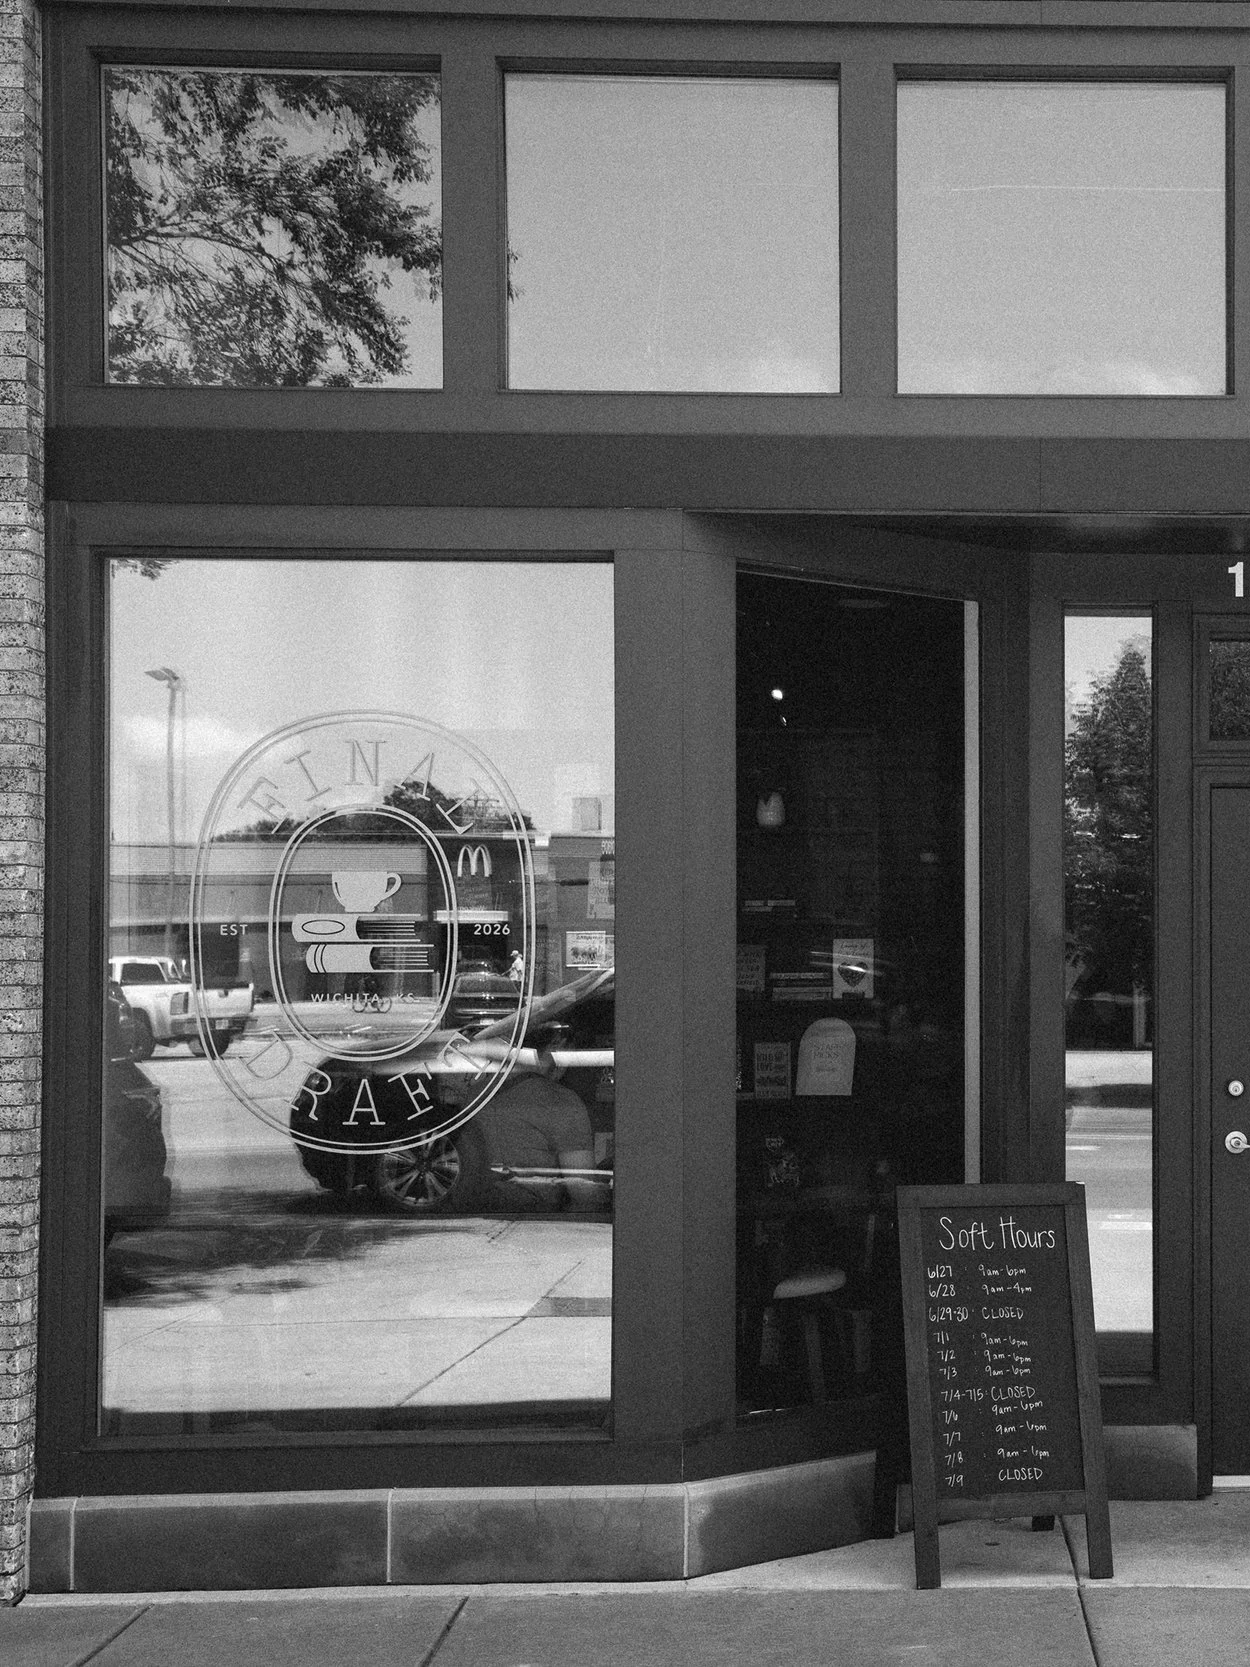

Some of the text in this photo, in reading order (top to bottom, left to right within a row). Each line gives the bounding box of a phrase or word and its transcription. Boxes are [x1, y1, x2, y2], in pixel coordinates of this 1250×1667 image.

[238, 740, 487, 834] FINAL
[220, 923, 248, 936] EST
[473, 923, 511, 936] 2026
[238, 1025, 492, 1125] DRAFT
[939, 1216, 1056, 1251] Soft Hours
[981, 1306, 1024, 1320] CLOSED
[991, 1385, 1036, 1401] CLOSED
[998, 1467, 1043, 1481] CLOSED
